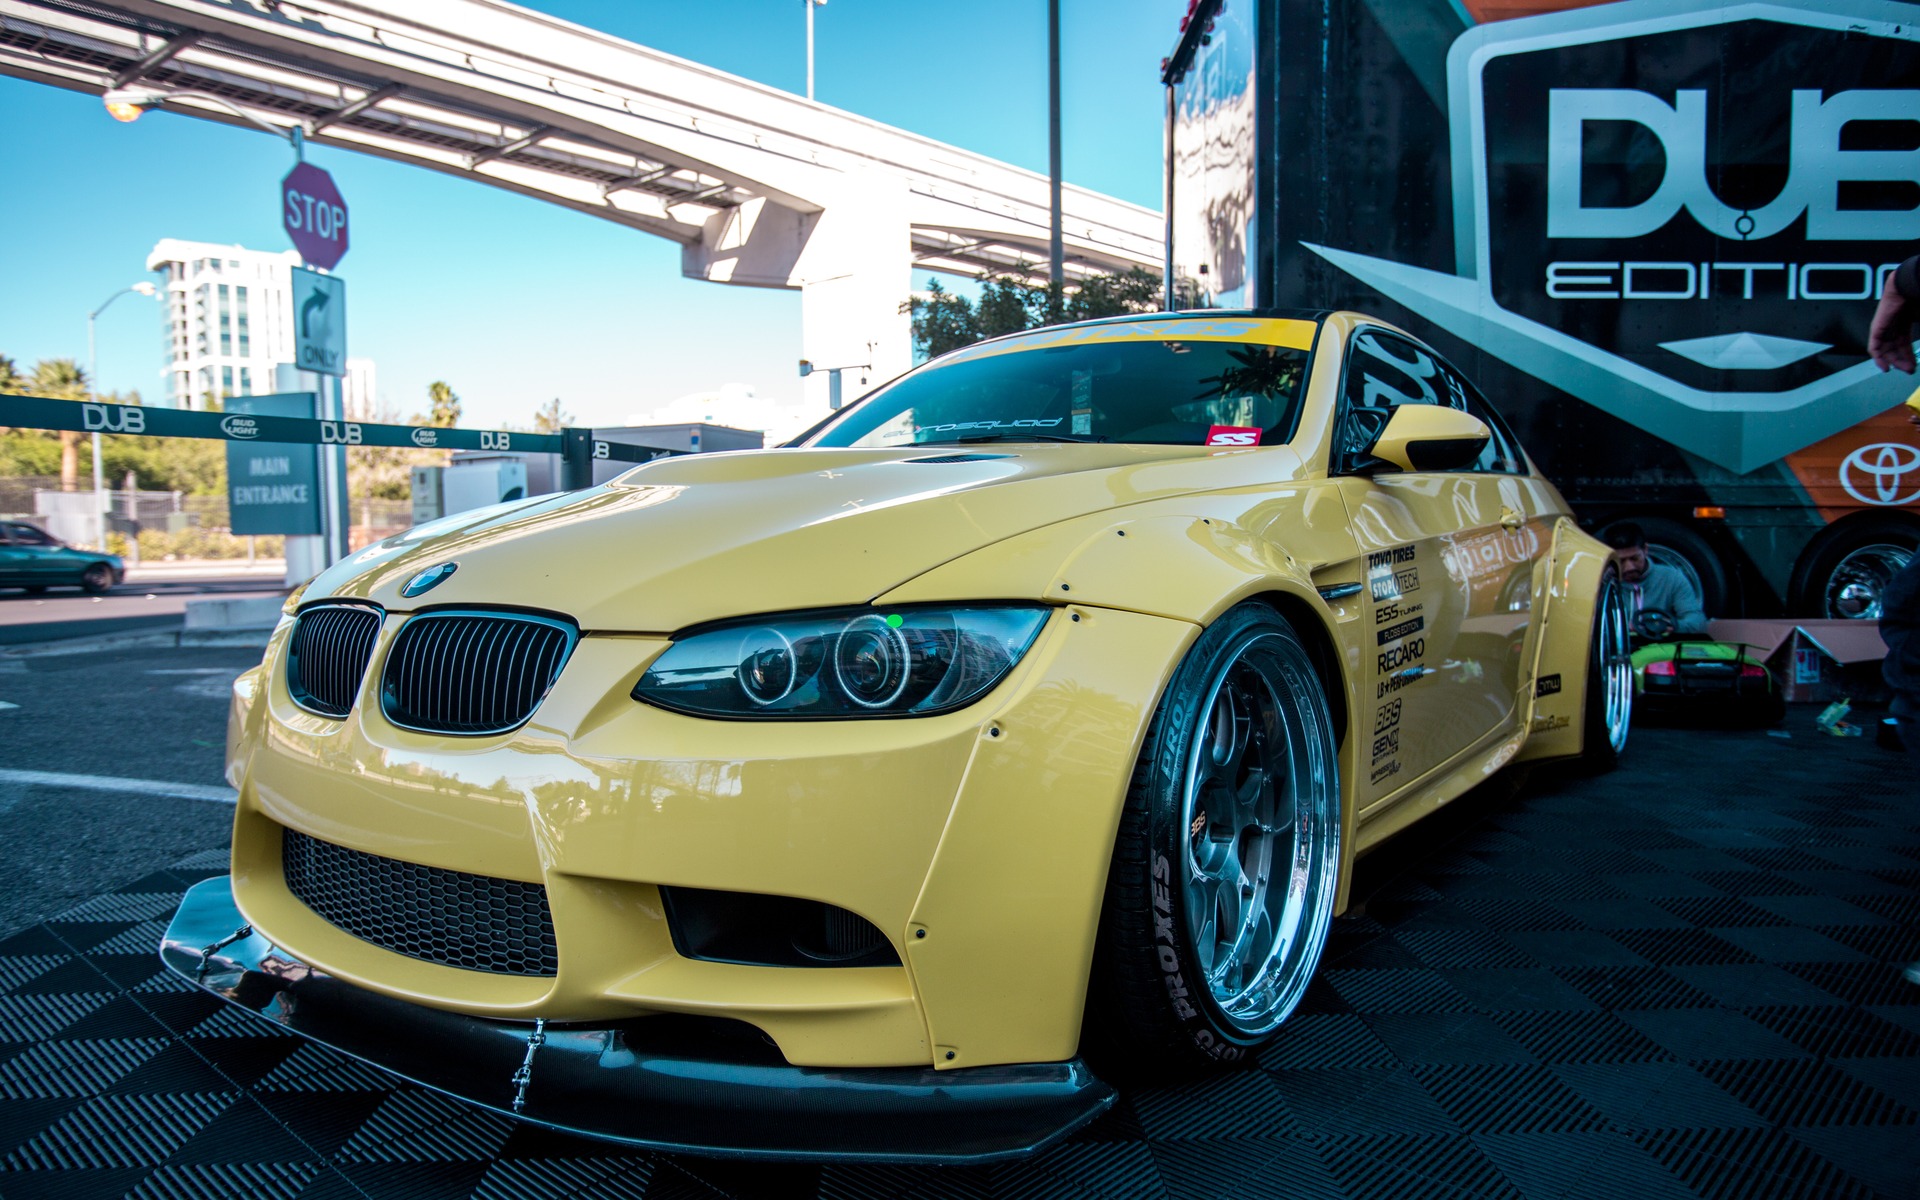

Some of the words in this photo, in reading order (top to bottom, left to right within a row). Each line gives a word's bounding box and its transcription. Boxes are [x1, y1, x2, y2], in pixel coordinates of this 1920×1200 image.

[1547, 88, 1920, 241] DUB
[286, 189, 346, 242] STOP
[1071, 321, 1262, 341] TIRES
[303, 345, 339, 368] ONLY
[82, 403, 146, 433] DUB
[231, 418, 256, 427] BUD
[226, 426, 259, 435] LIGHT
[320, 421, 363, 445] DUB
[480, 431, 510, 450] DUB
[1209, 432, 1257, 446] SS
[249, 457, 290, 477] MAIN
[233, 484, 308, 505] ENTRANCE
[1368, 550, 1392, 570] TOYO
[1391, 545, 1415, 564] TIRES
[1372, 579, 1393, 599] STOP
[1398, 570, 1419, 591] TECH
[1375, 603, 1399, 625] ESS
[1399, 603, 1424, 616] TUNING
[1384, 627, 1401, 640] FLOSS
[1400, 621, 1420, 634] EDITION
[1377, 637, 1425, 676] RECARO
[1374, 697, 1402, 735] BBS
[1152, 851, 1198, 1021] PROXES
